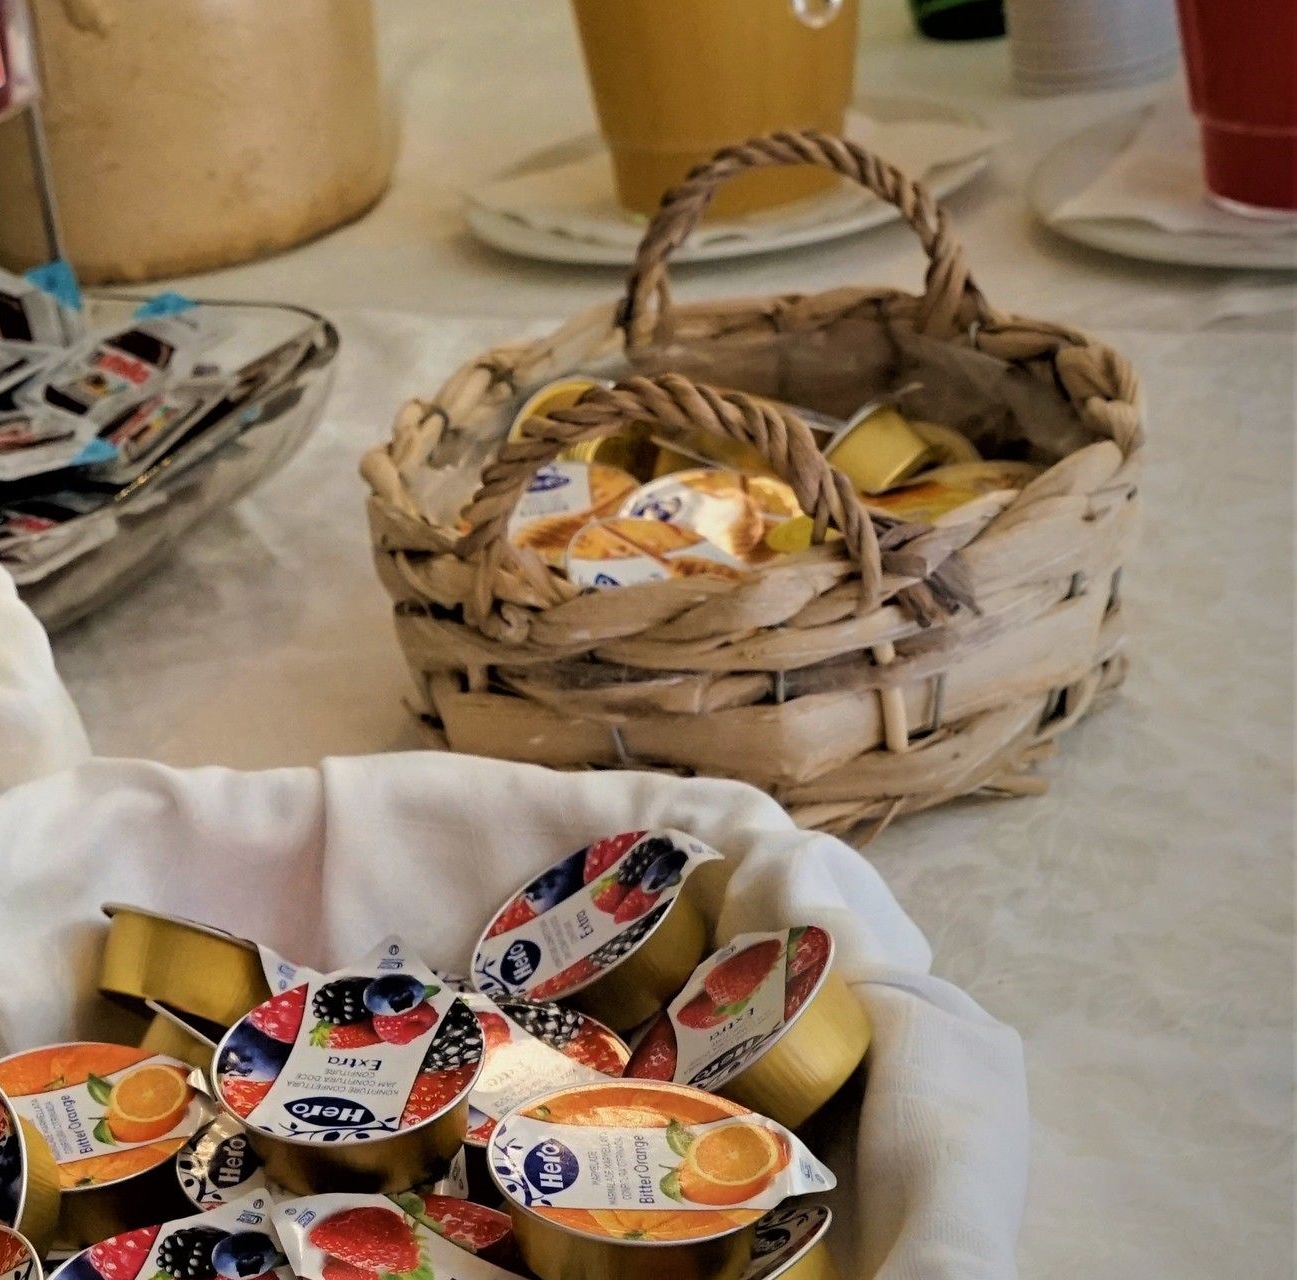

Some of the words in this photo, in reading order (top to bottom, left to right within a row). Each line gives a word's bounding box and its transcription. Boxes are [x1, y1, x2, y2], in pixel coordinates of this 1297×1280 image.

[507, 943, 533, 981] Hero
[327, 1055, 383, 1071] Extra
[60, 1094, 82, 1130] Orange
[291, 1103, 366, 1123] Hero
[74, 1129, 94, 1155] Bitter
[217, 1136, 248, 1184] Hero
[633, 1134, 649, 1174] Orange
[536, 1143, 564, 1189] Hero
[638, 1175, 655, 1205] Bitter
